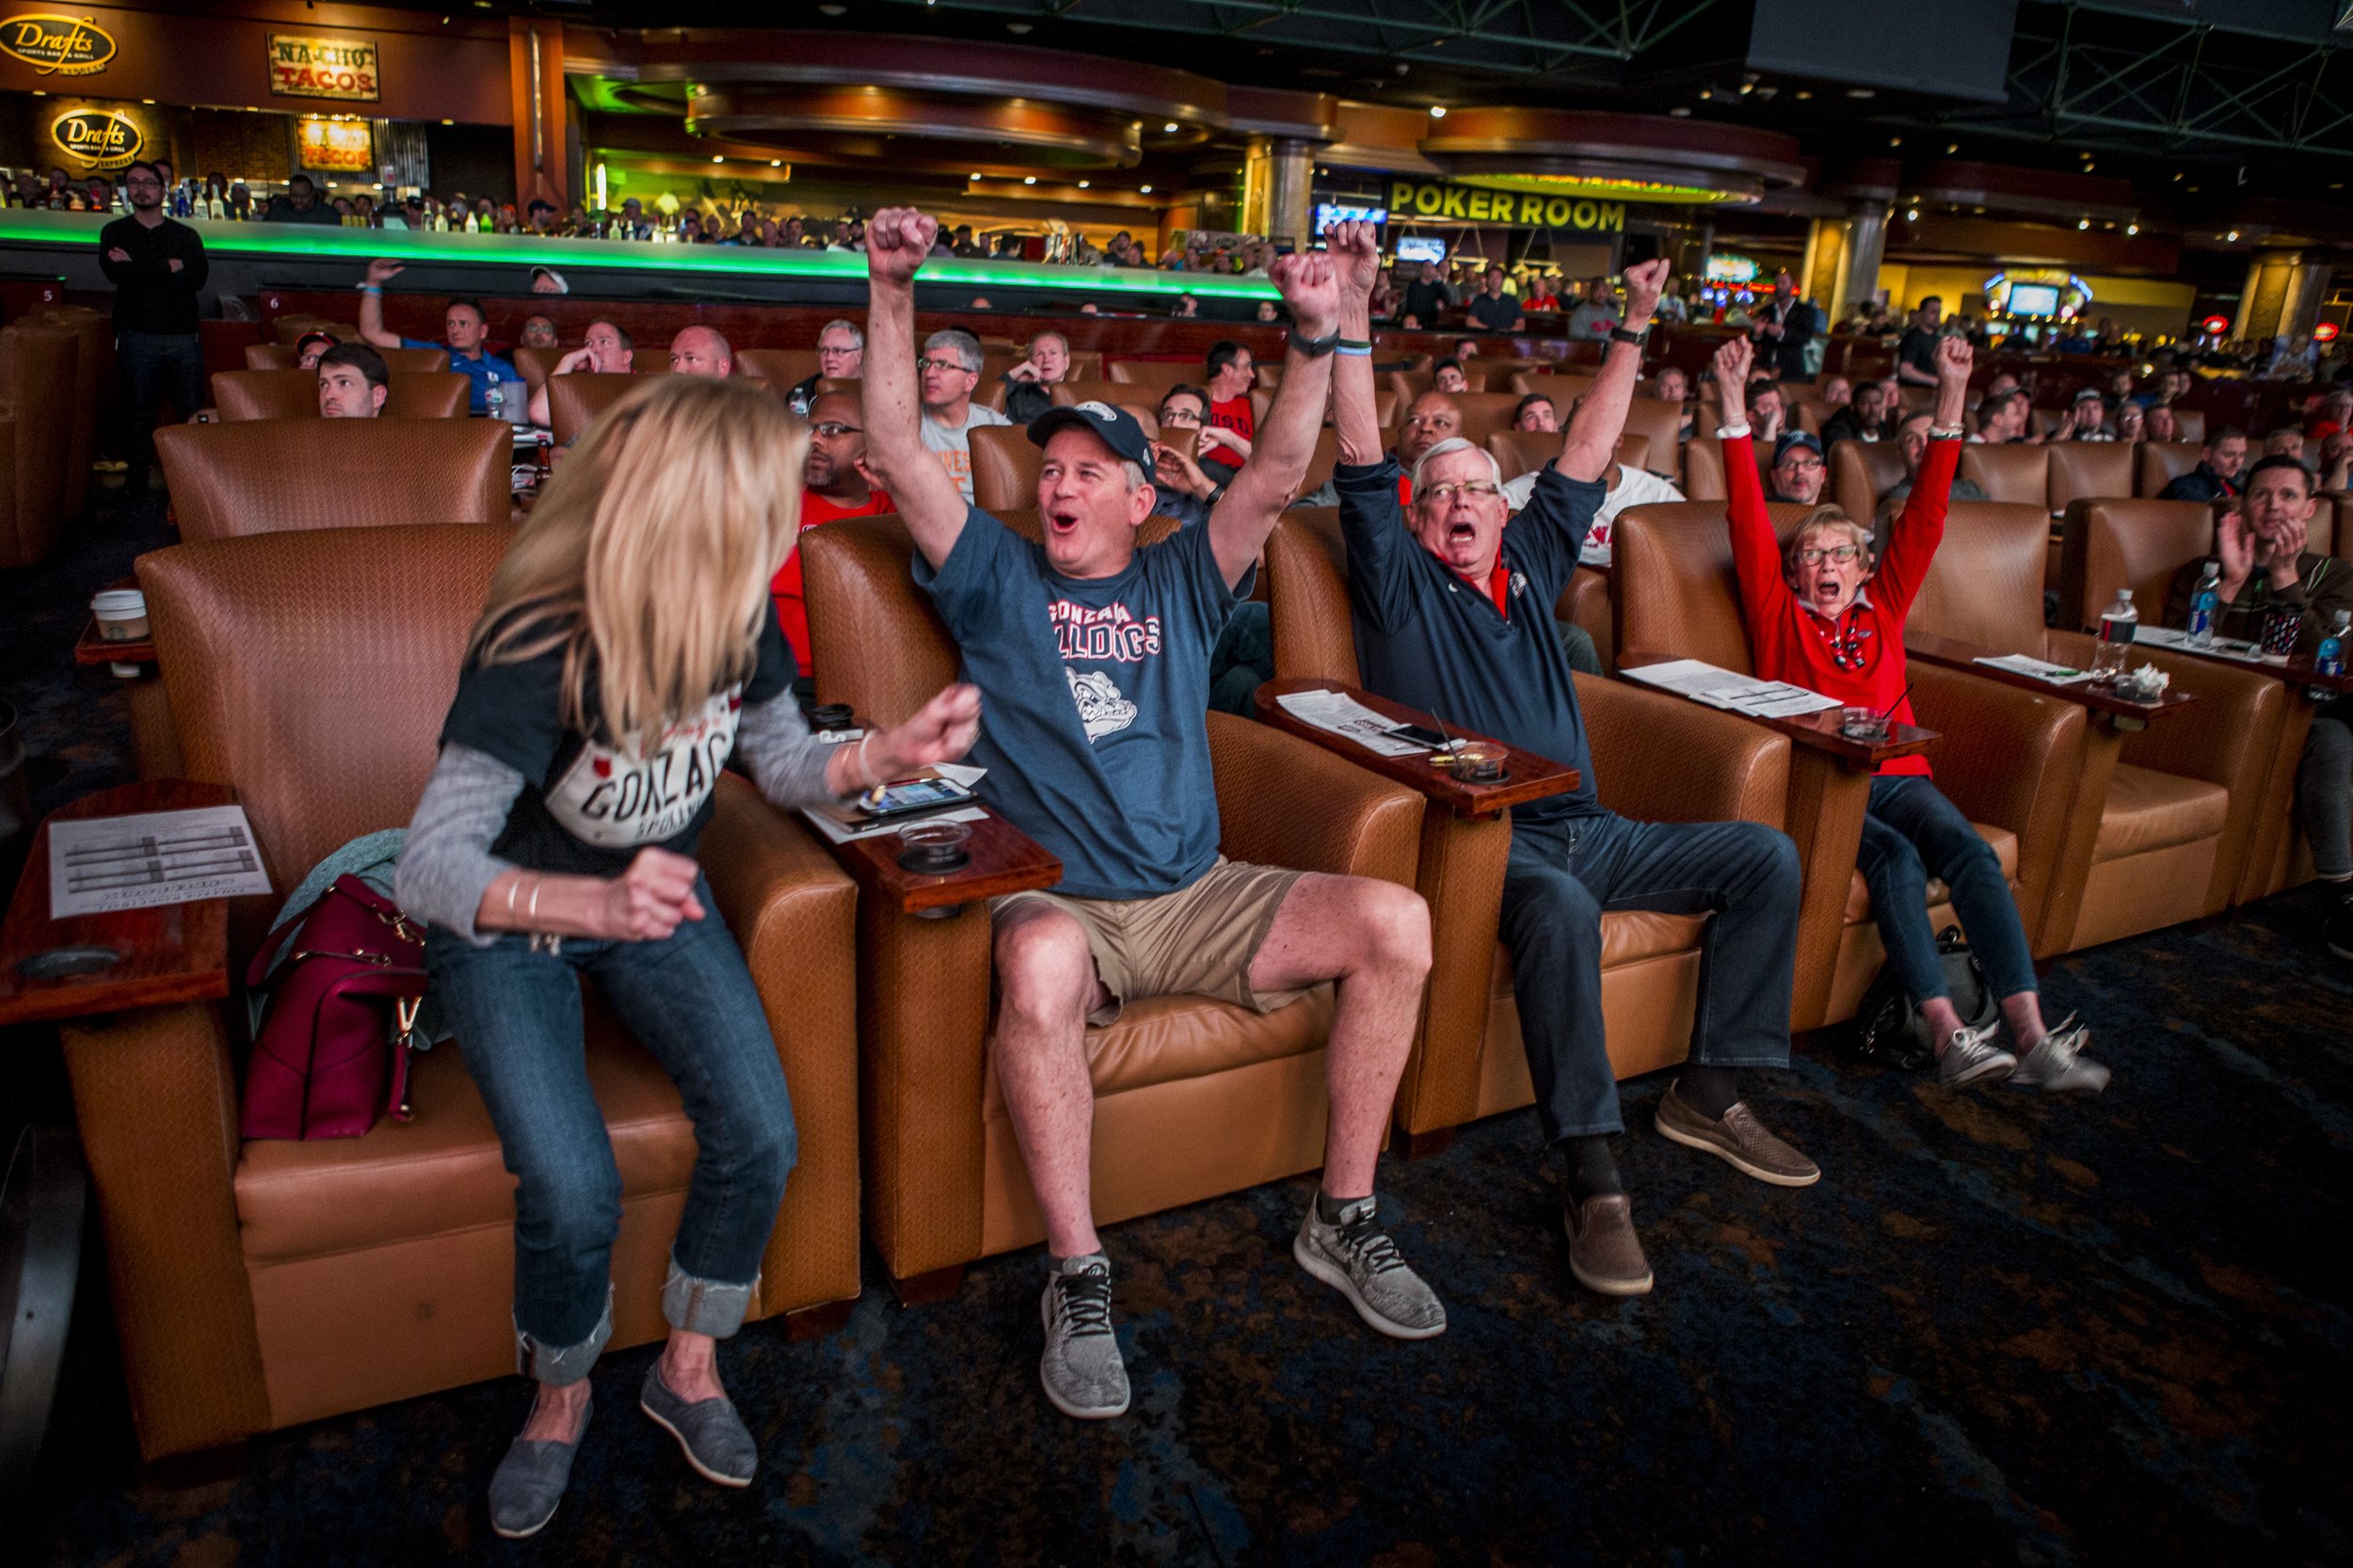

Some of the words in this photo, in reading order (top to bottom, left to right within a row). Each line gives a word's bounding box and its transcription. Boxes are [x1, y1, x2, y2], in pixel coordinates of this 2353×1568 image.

[15, 16, 95, 68] Drafts
[17, 47, 46, 56] SPORTS
[277, 41, 365, 68] NACHO
[278, 65, 373, 91] TACOS
[67, 110, 126, 161] Drafts
[305, 146, 369, 167] TACOS
[1391, 183, 1514, 222] POKER
[1520, 194, 1626, 232] ROOM
[43, 290, 53, 302] 5
[269, 296, 280, 310] 6
